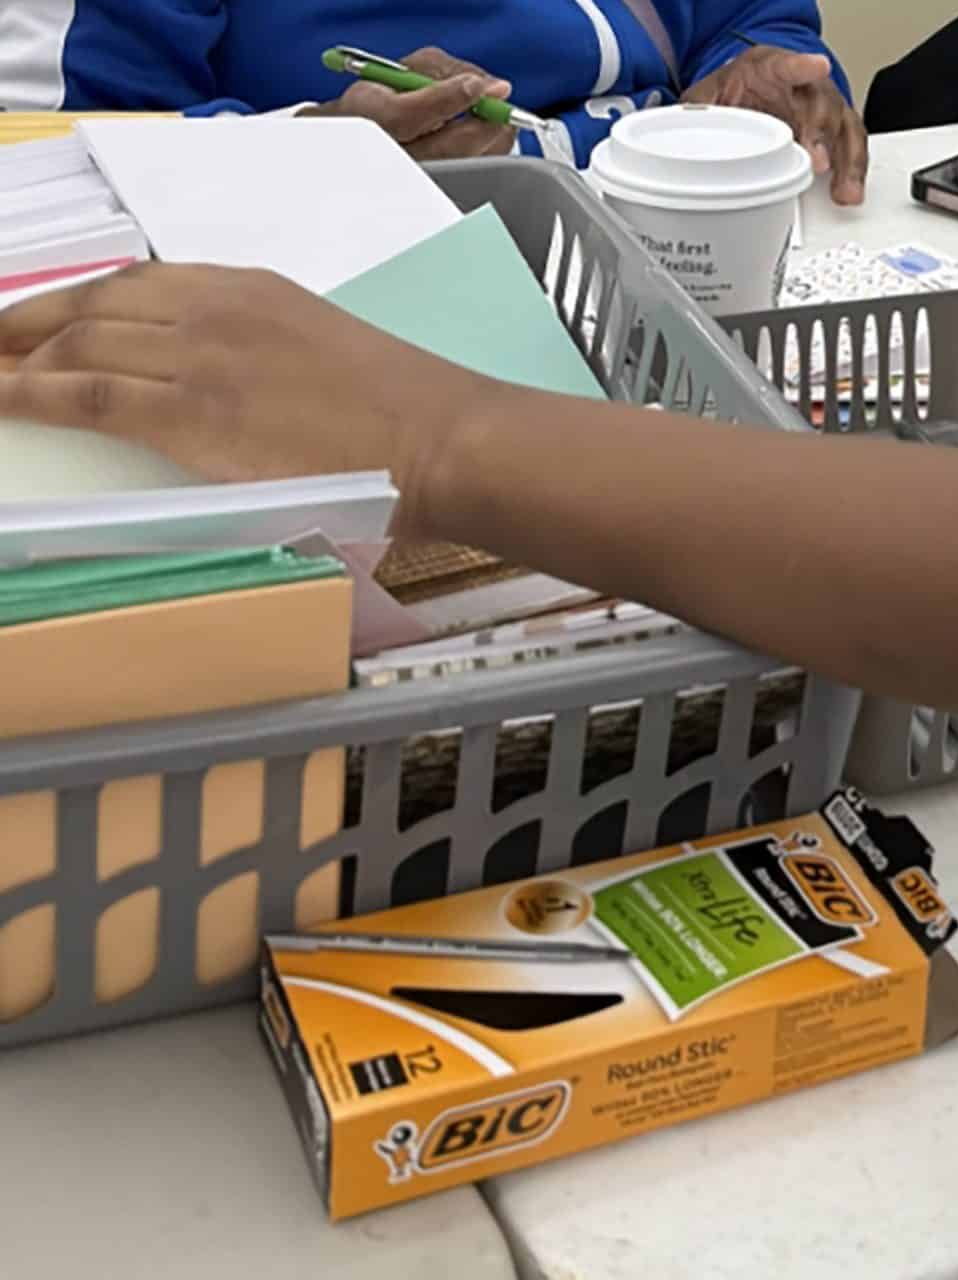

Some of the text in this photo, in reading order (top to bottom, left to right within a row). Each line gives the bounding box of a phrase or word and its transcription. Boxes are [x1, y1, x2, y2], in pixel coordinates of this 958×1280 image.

[676, 240, 711, 256] first
[795, 860, 866, 919] BIC
[901, 872, 942, 913] BIC
[405, 1044, 443, 1078] 12
[608, 1044, 681, 1084] Round
[432, 1094, 557, 1158] BIC
